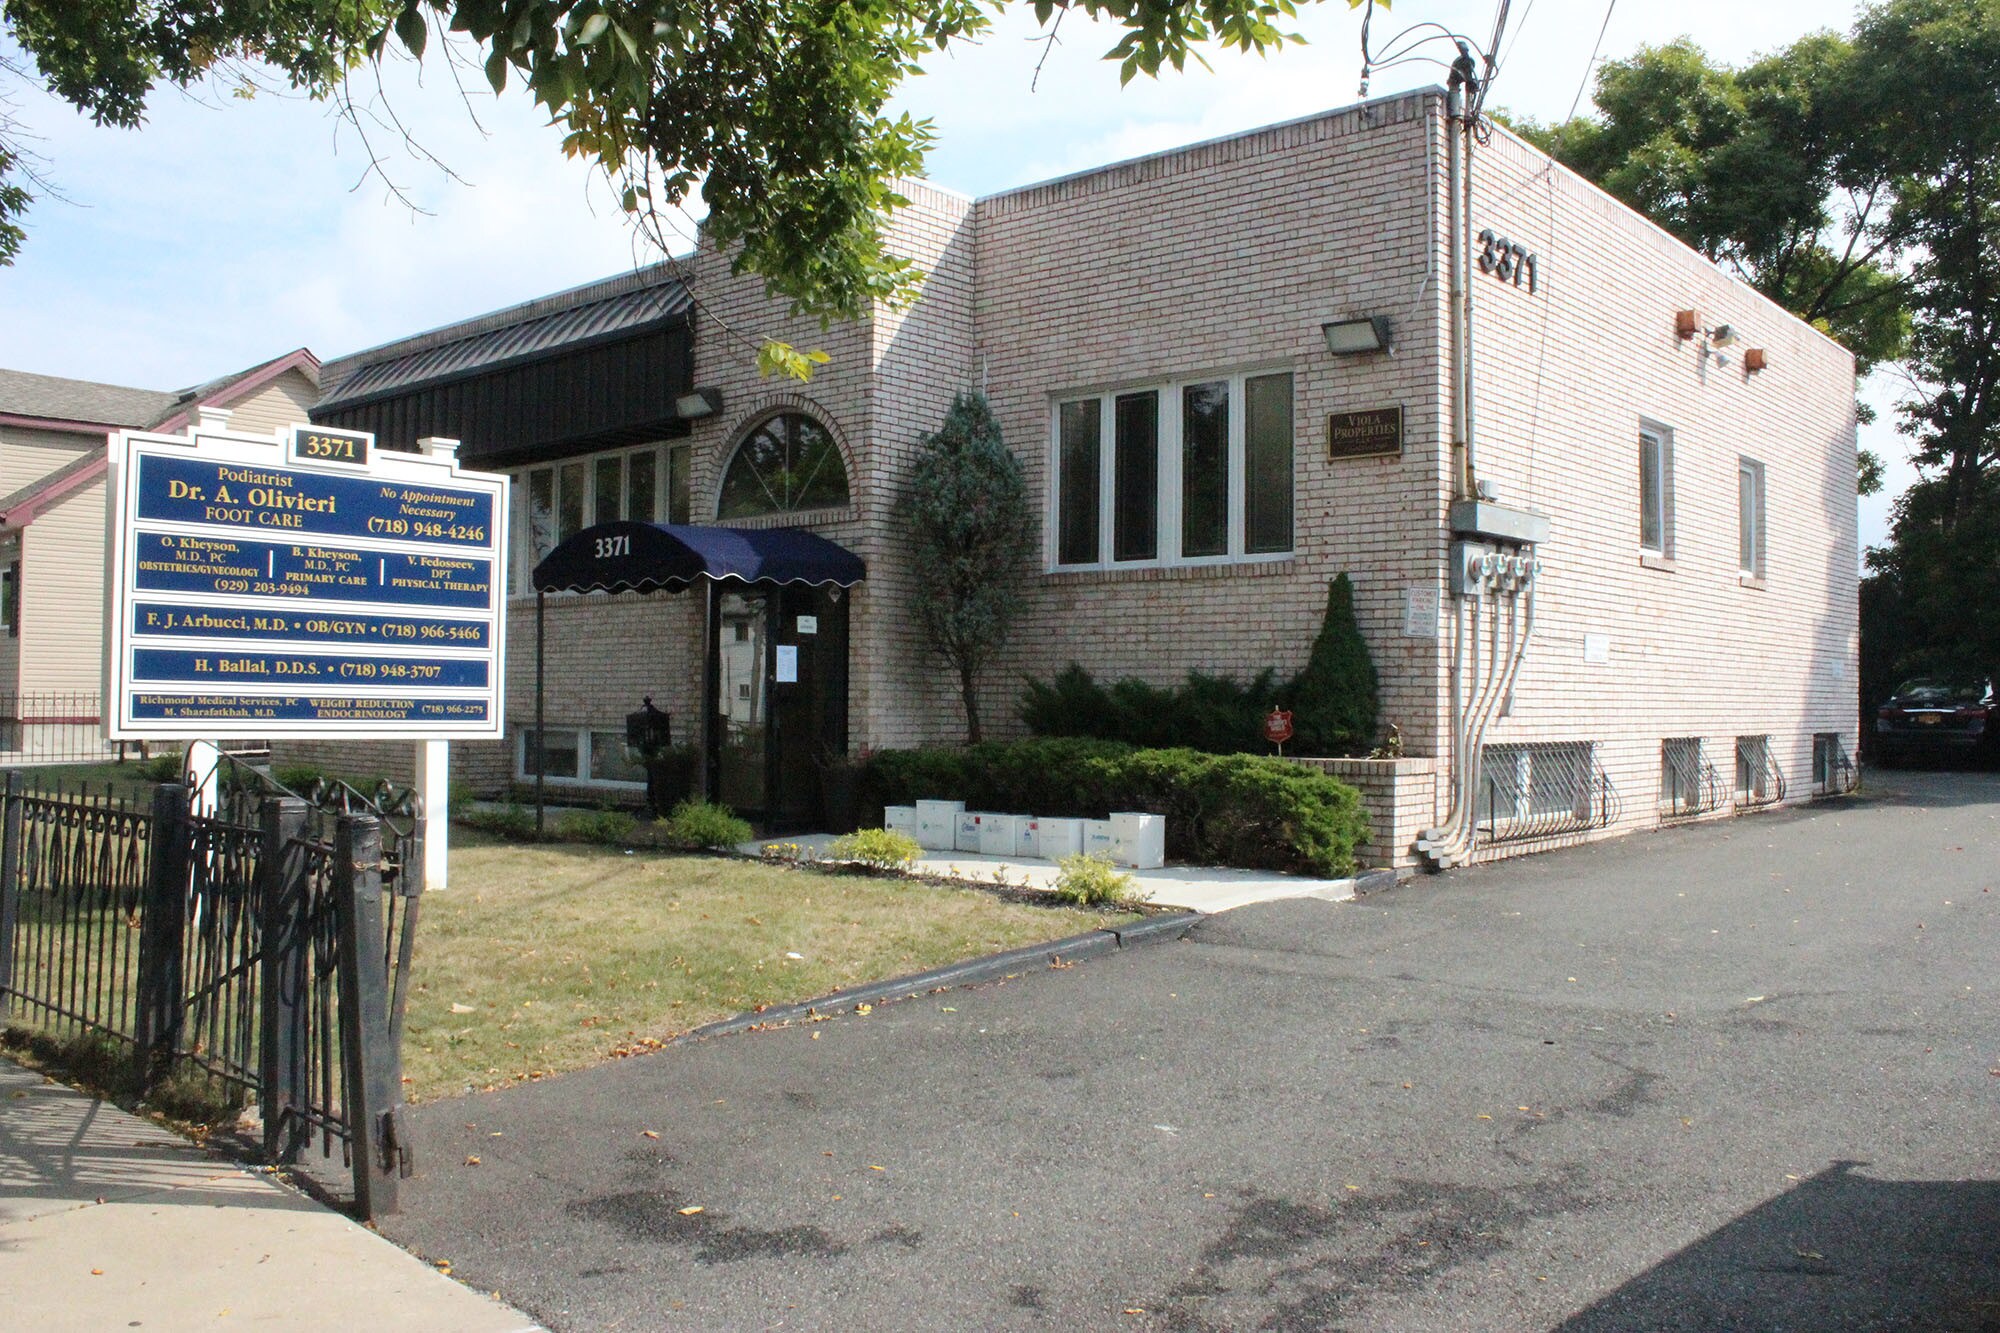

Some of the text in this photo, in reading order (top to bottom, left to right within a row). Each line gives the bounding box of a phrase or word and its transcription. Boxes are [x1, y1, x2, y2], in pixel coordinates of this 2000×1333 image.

[1478, 229, 1536, 294] 3371
[1348, 415, 1380, 426] VIOLA
[1334, 424, 1396, 439] PROPERTIES
[307, 436, 355, 457] 3371
[218, 467, 293, 487] Podiatrist
[168, 480, 336, 514] Dr. A. Olivieri
[380, 487, 475, 507] No Appointment
[206, 506, 303, 528] FOOT CARE
[399, 504, 456, 521] Necessary
[368, 516, 484, 541] (718) 948-4246
[161, 536, 240, 553] O. Kheyson,
[594, 536, 630, 558] 3371
[210, 554, 226, 564] PC
[292, 546, 362, 562] B. Kheyson,
[139, 561, 259, 578] OBSTETRICS/GYNECOLOGY
[335, 562, 350, 572] PC
[408, 556, 475, 570] V. Fedosseev,
[286, 572, 367, 586] PRIMARY CARE
[431, 569, 452, 579] DPT
[214, 578, 309, 596] (929) 203-9494
[392, 578, 488, 593] PHYSICAL THERAPY
[147, 612, 480, 640] F. J. Arbucci, M.D. OB/GYN (718) 966-5466
[195, 659, 441, 678] H. Ballal, D.D.S. (718) 948-3707
[140, 696, 194, 705] Richmond
[198, 696, 236, 706] Medical
[286, 698, 299, 706] PC
[310, 698, 414, 710] WEIGHT REDUCTION
[422, 704, 484, 714] (718) 966-2275
[164, 708, 176, 716] M.
[254, 709, 276, 718] M.D.
[317, 709, 408, 719] ENDOCRINOLOGY
